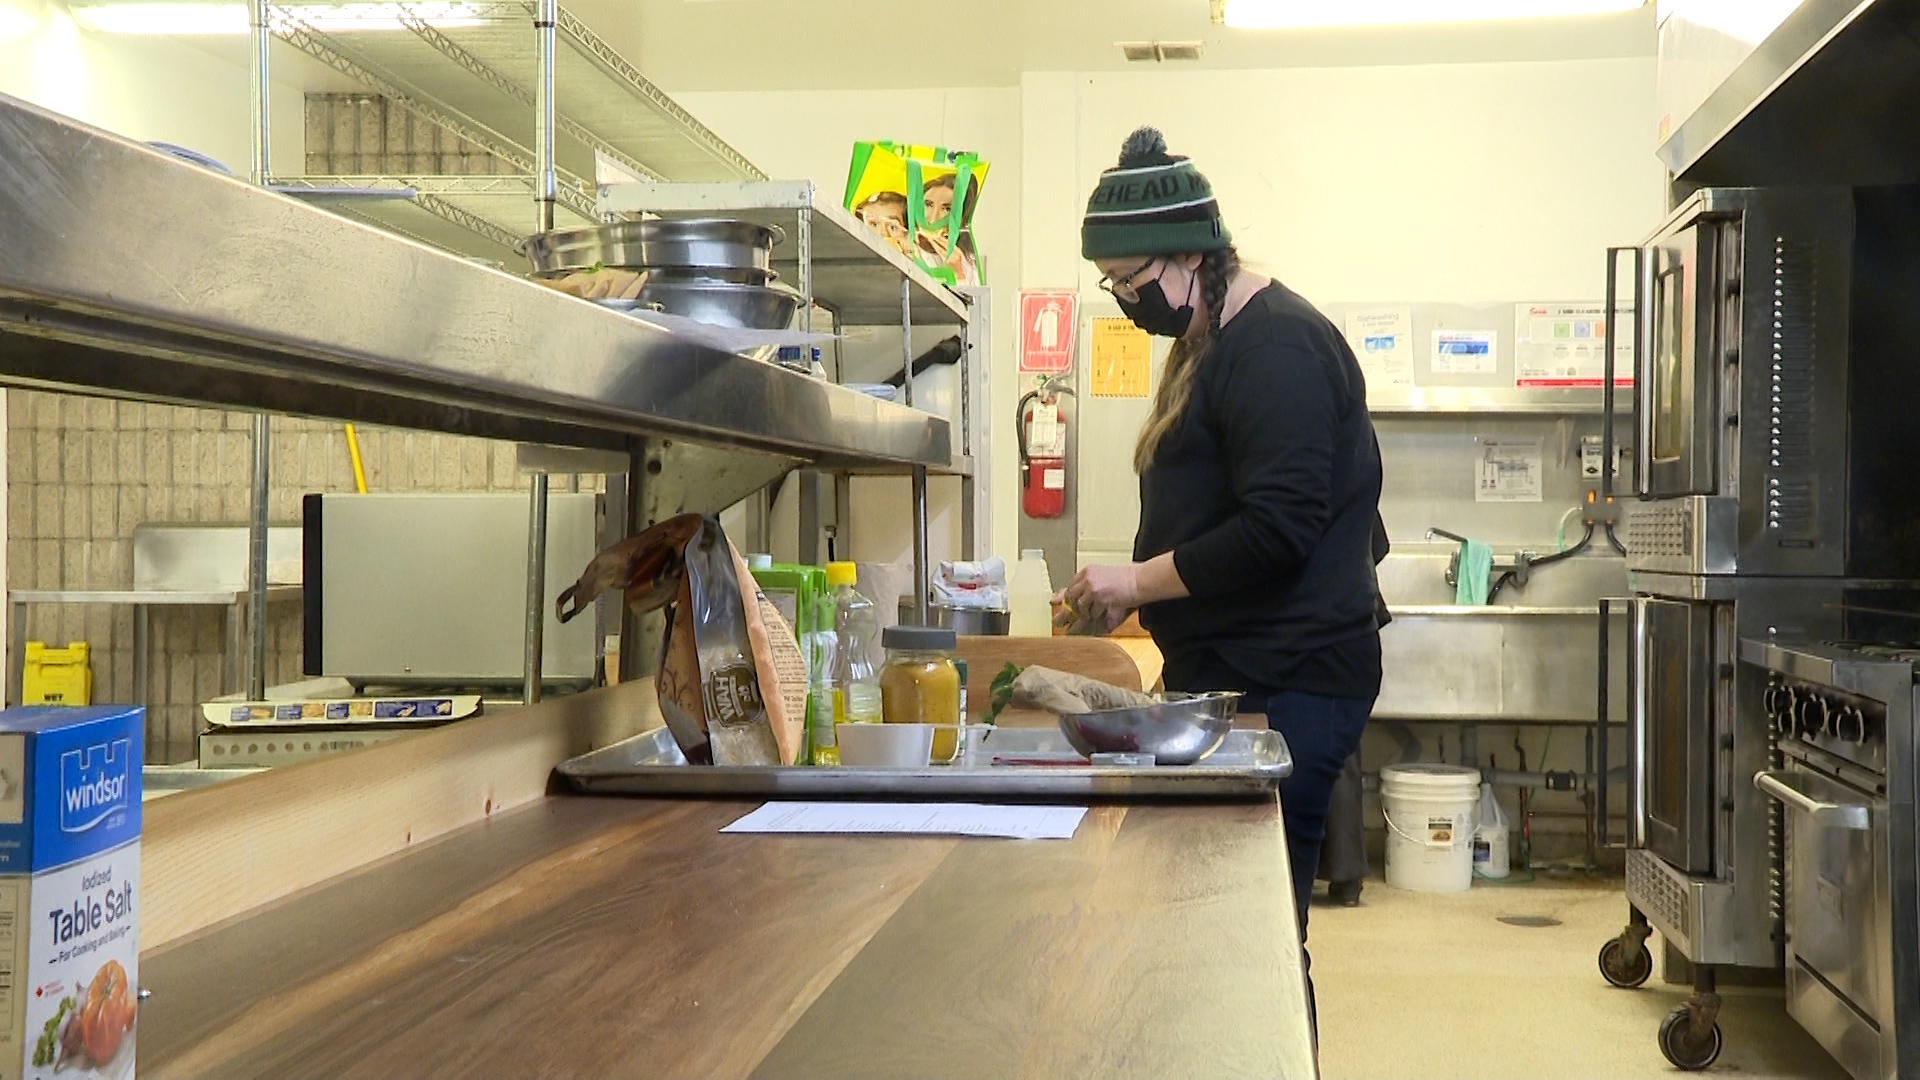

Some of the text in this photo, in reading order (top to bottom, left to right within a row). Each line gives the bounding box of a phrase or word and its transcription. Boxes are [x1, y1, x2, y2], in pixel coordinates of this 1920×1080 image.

[66, 771, 126, 813] windsor
[82, 866, 112, 891] Iodized
[49, 879, 132, 946] Table Salt
